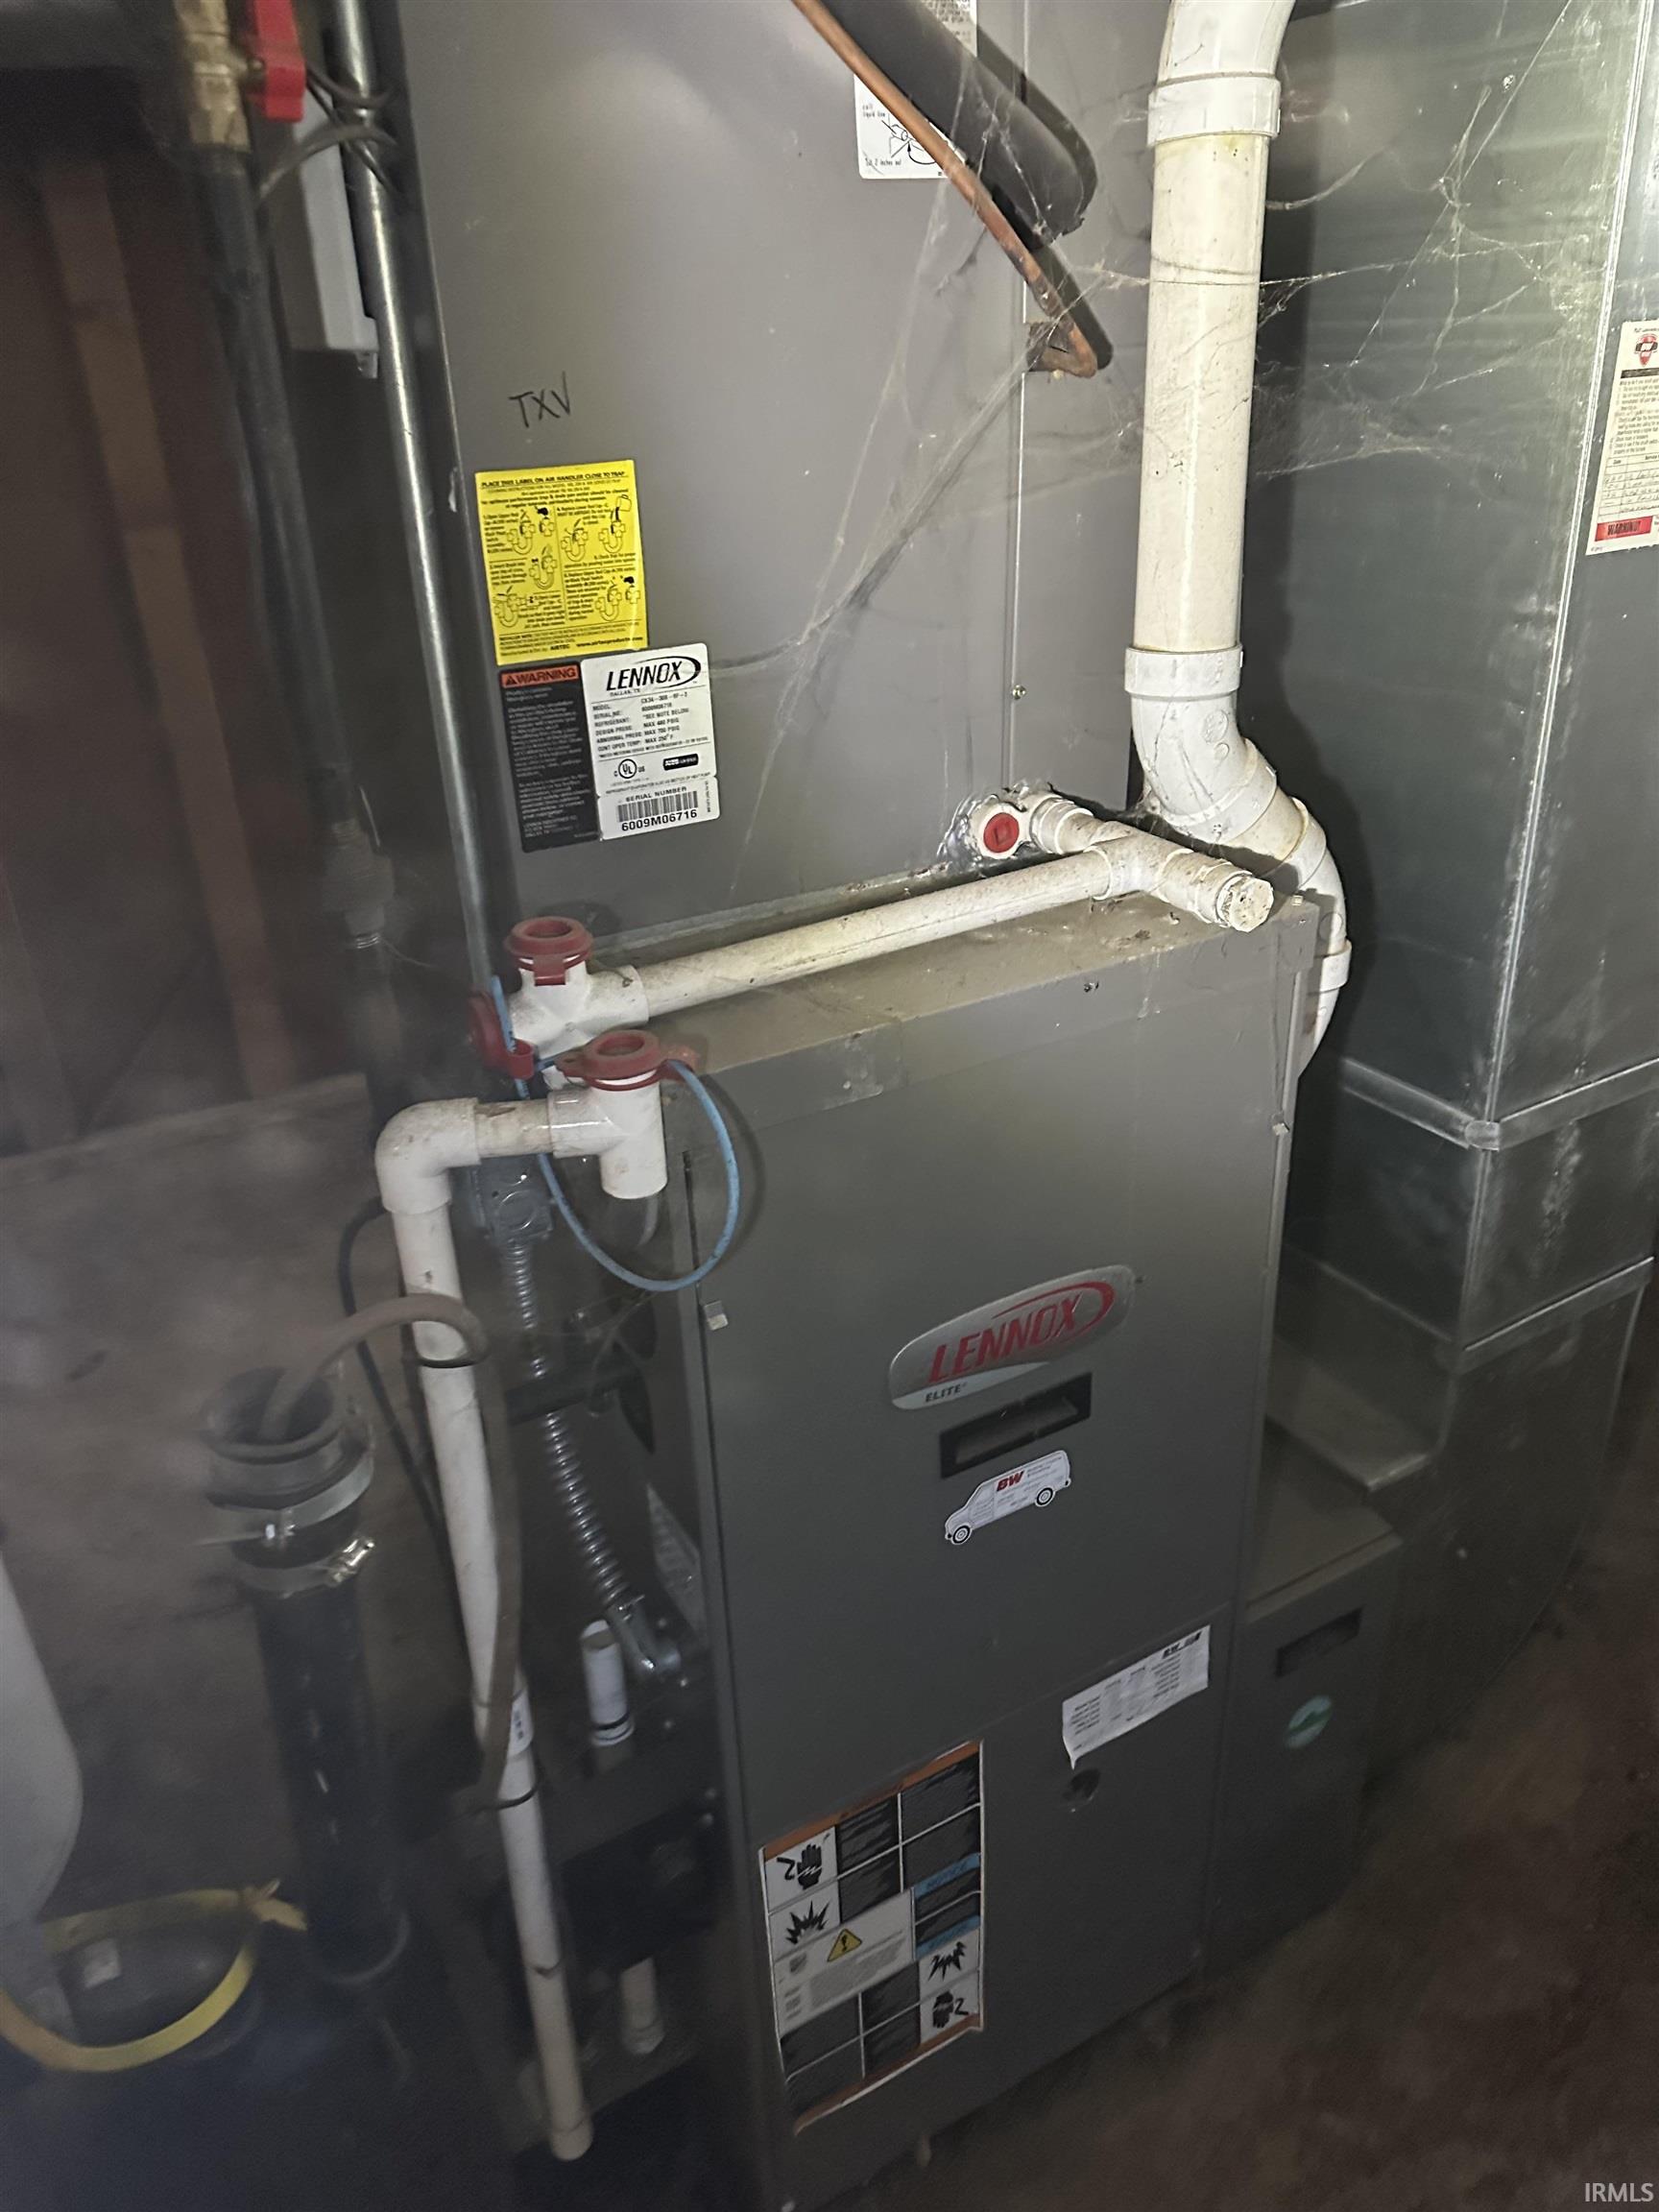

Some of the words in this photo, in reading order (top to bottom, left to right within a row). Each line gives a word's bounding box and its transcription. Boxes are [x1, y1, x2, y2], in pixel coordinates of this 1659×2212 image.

[508, 371, 570, 428] TXV
[517, 667, 576, 684] WARNING
[606, 661, 683, 691] LENNOX
[626, 793, 651, 803] SERIAL
[654, 786, 687, 797] NUMBER
[622, 809, 697, 831] 6009M06716
[928, 1291, 1083, 1383] LENNOX
[997, 1470, 1025, 1492] BW
